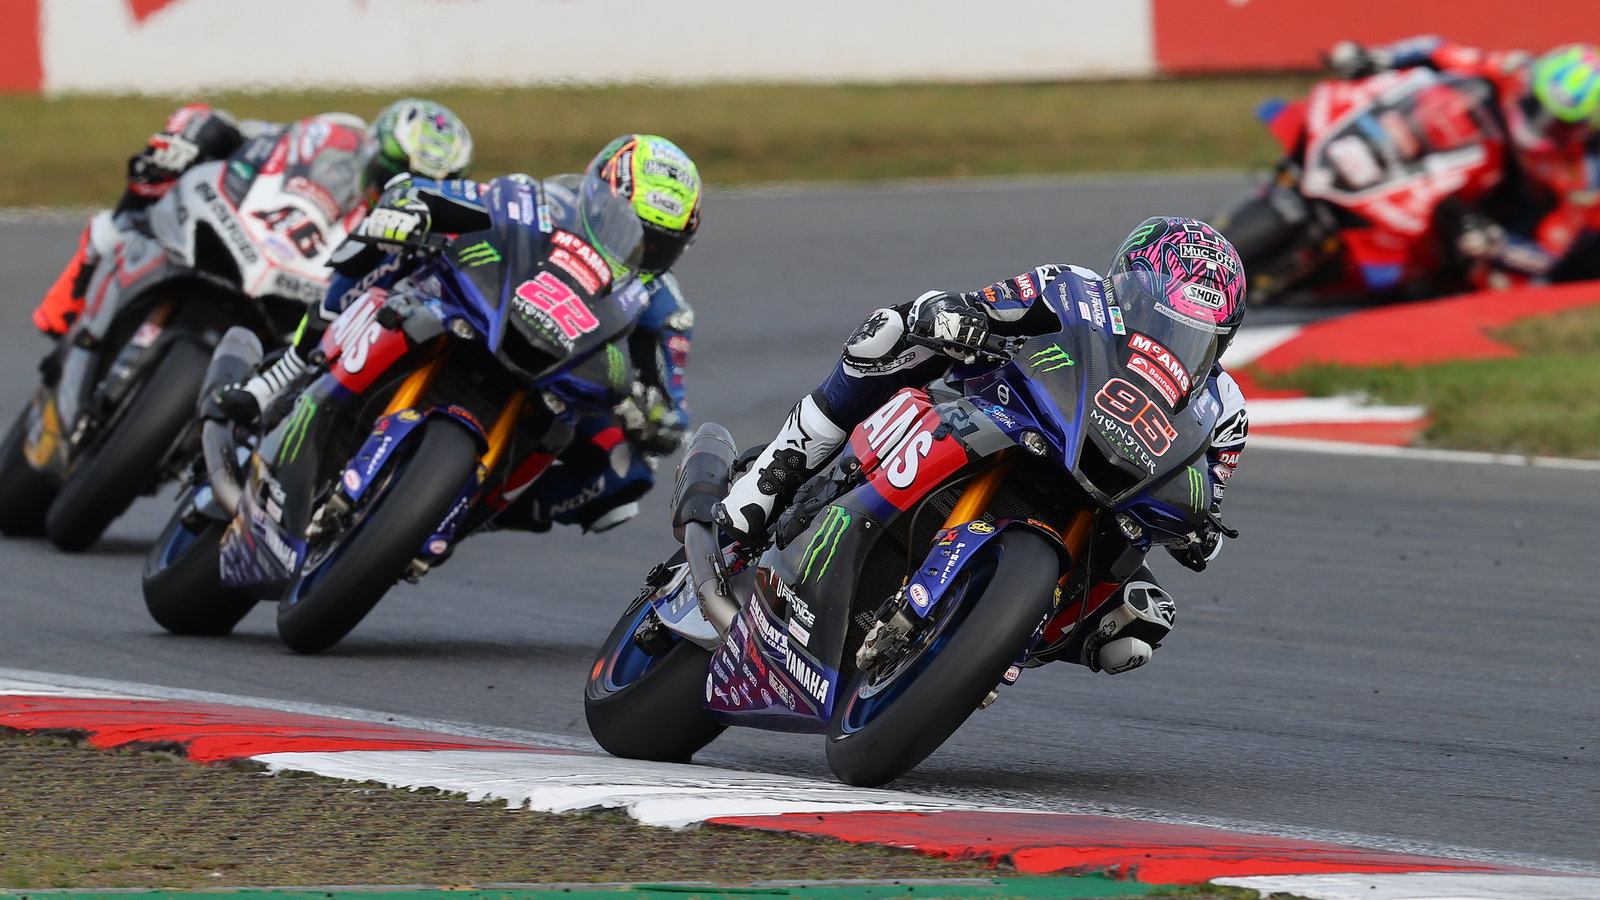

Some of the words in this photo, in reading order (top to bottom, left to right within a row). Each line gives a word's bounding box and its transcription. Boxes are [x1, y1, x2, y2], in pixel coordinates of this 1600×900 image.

[556, 231, 611, 285] McAMS
[1183, 245, 1236, 270] Muc-Off
[515, 271, 600, 340] 22
[1189, 286, 1221, 306] SHOEI
[1132, 335, 1189, 393] McAMS
[1149, 367, 1178, 400] Bennetts
[862, 391, 934, 488] AMS
[1091, 409, 1156, 474] MONSTER
[1101, 430, 1141, 466] ENERGY
[940, 542, 966, 584] PIRELLI
[785, 647, 830, 704] YAMAHA
